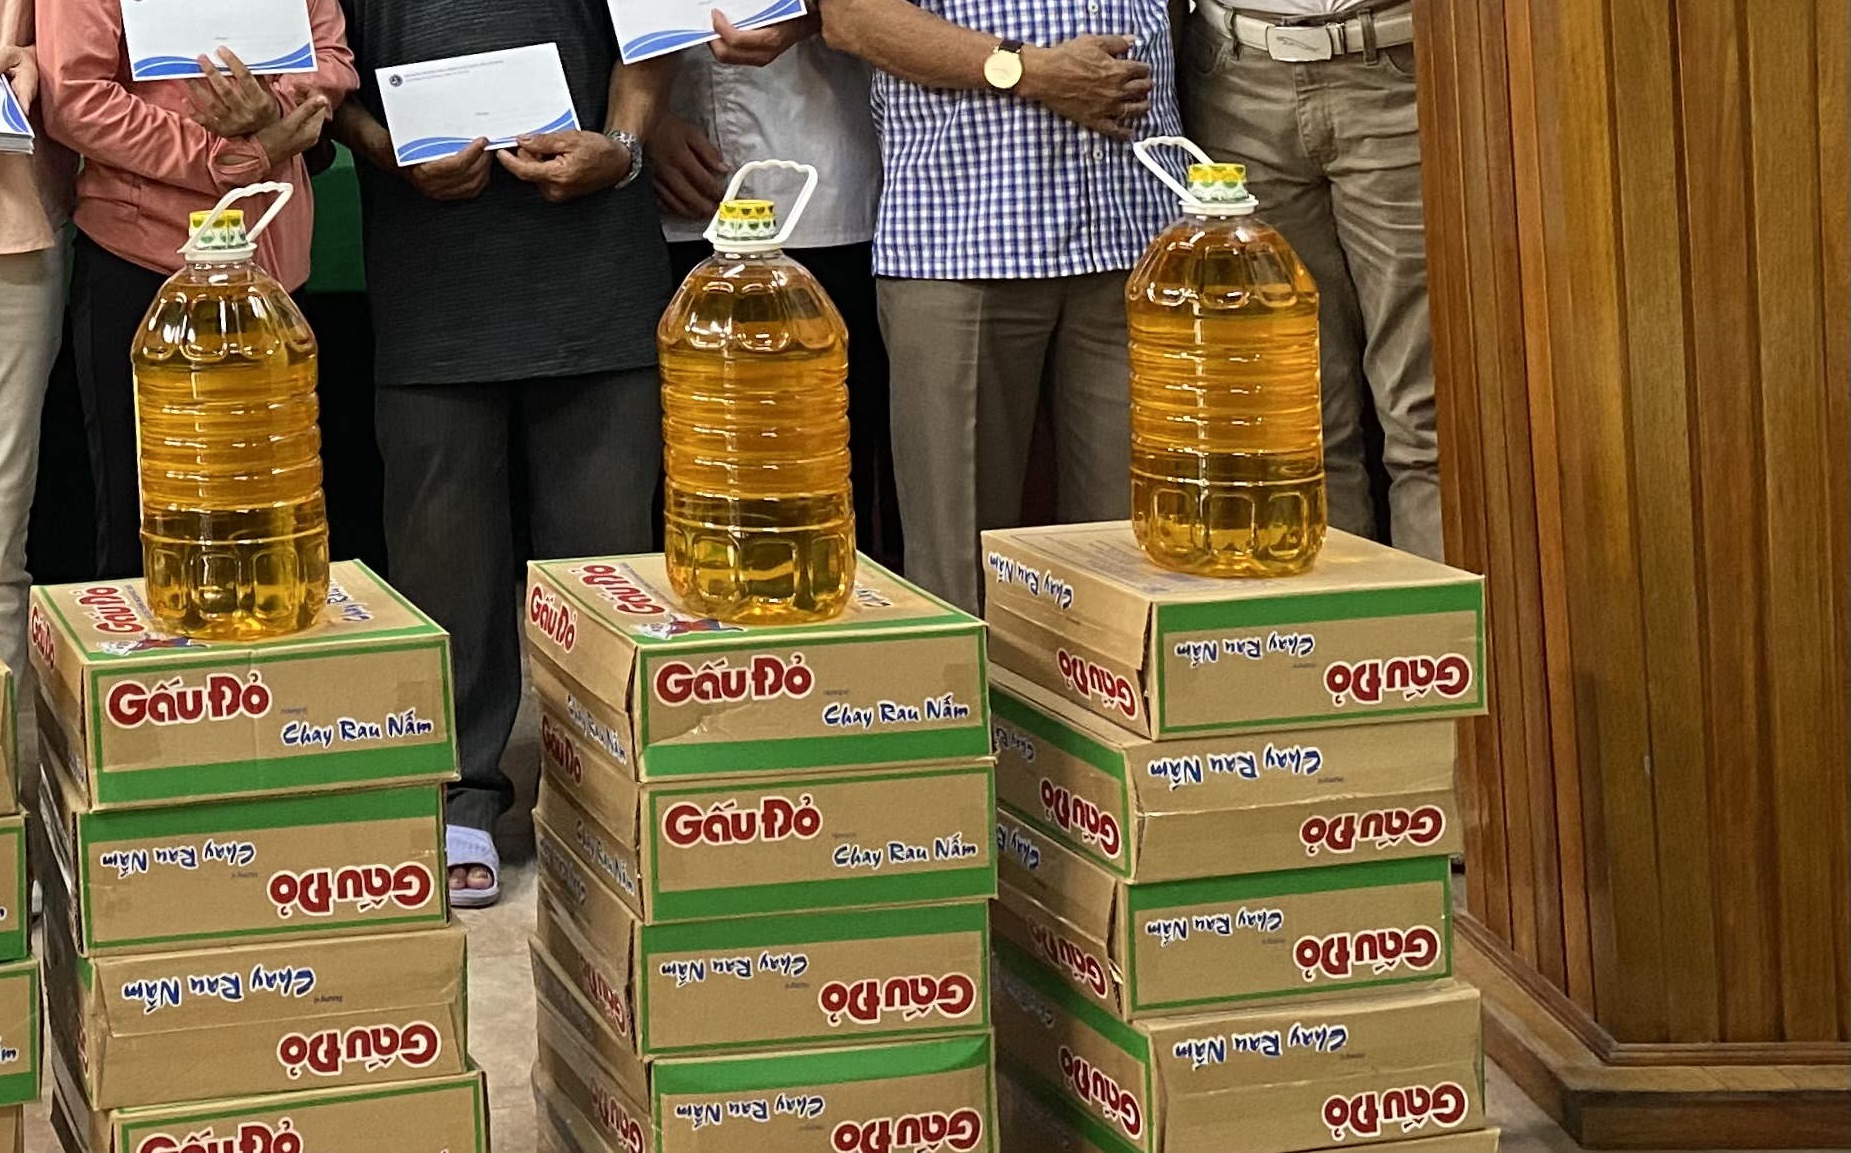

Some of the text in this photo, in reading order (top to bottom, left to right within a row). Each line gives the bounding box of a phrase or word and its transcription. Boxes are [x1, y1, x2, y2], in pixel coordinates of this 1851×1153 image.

[1176, 632, 1314, 667] Chay Rau Nấm
[109, 671, 270, 726] Gấu Đỏ
[656, 654, 812, 704] Gấu Đỏ
[1058, 649, 1137, 718] Gấu Đỏ
[1326, 655, 1470, 705] Gấu Đỏ
[283, 708, 433, 747] Chay Rau Nấm
[824, 693, 970, 728] Chay Rau Nấm
[1148, 743, 1322, 790] Chay Rau Nấm
[665, 795, 821, 845] Gấu Đỏ
[1302, 807, 1443, 855] Gấu Đỏ
[101, 839, 256, 878] Chay Rau Nấm
[833, 846, 882, 868] Chay
[888, 842, 928, 861] Rau
[935, 833, 978, 859] Nấm
[269, 863, 432, 916] Gấu Đỏ
[1148, 907, 1283, 947] Chay Rau Nấm
[661, 952, 809, 988] Chay Rau Nấm
[1296, 928, 1439, 980] Gấu Đỏ
[124, 965, 315, 1014] Chay Rau Nấm
[820, 974, 975, 1024] Gấu Đỏ
[280, 1023, 439, 1077] Gấu Đỏ
[1174, 1023, 1348, 1070] Chay Rau Nấm
[675, 1094, 824, 1130] Chay Rau Nấm
[896, 1110, 982, 1153] Gấu
[1323, 1083, 1467, 1141] Gấu Đỏ
